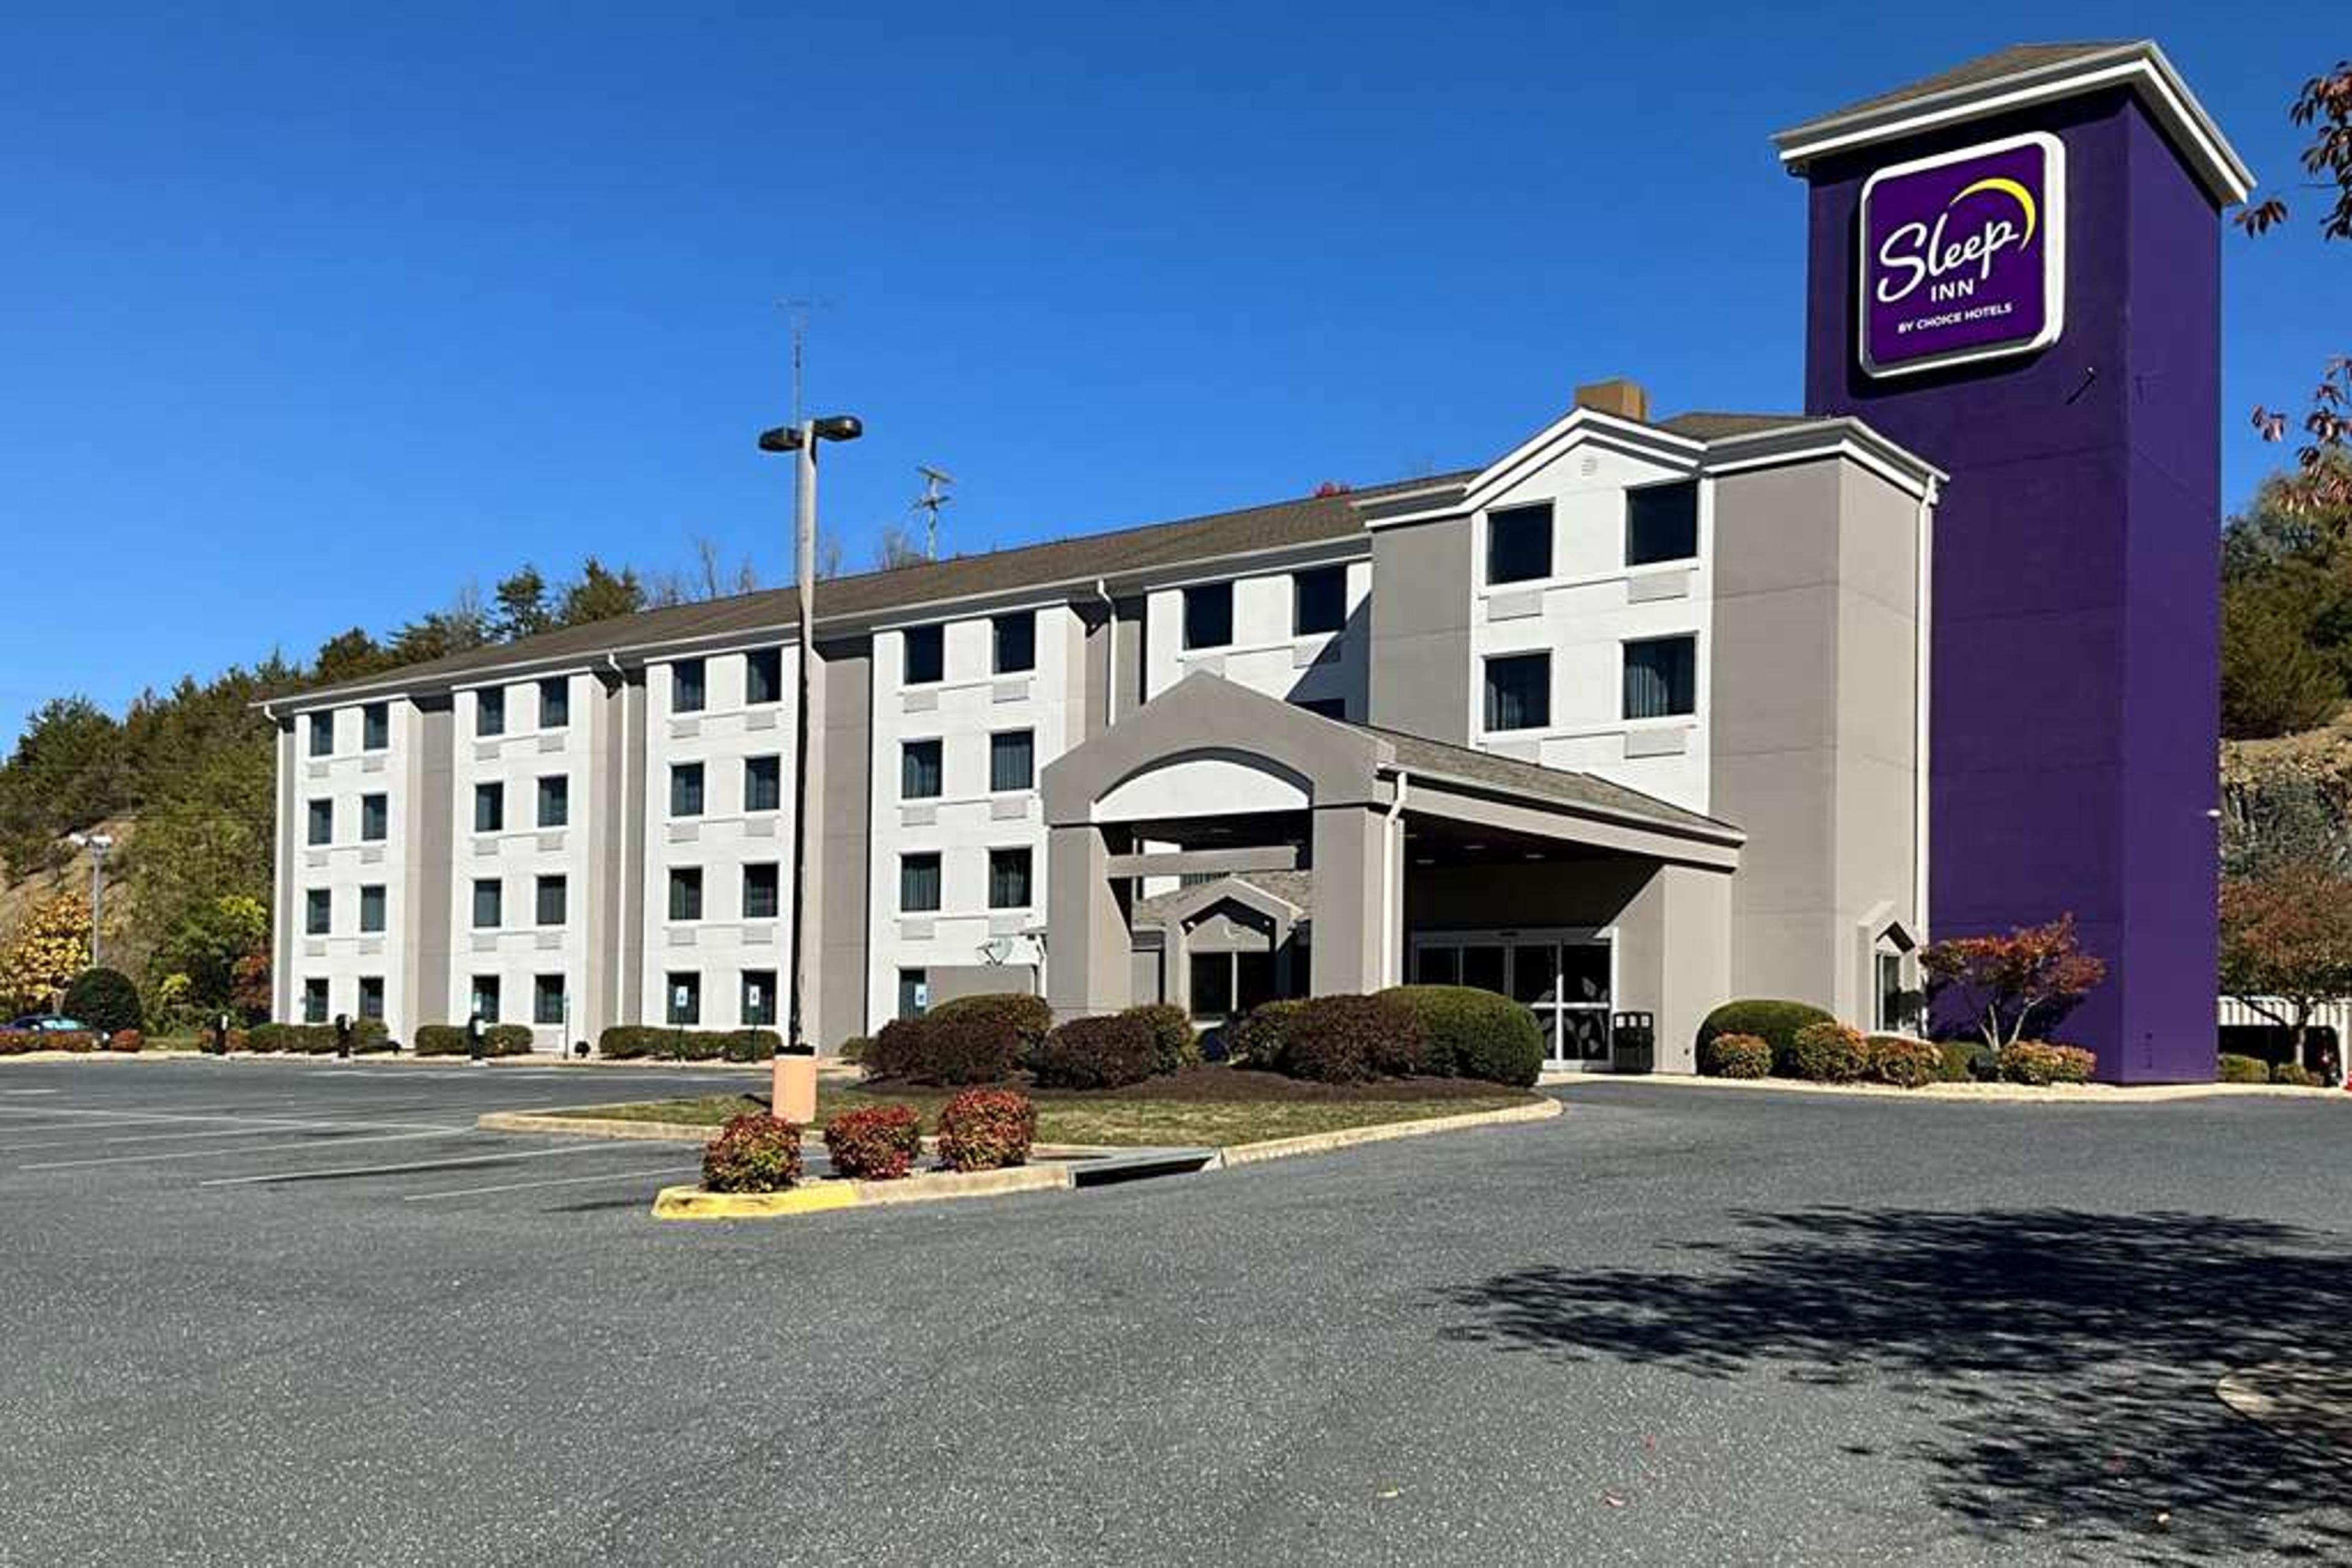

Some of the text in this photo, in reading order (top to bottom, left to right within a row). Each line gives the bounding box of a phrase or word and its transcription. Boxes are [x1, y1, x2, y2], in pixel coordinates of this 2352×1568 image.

[1877, 213, 2019, 303] Sleep
[1931, 278, 1974, 302] INN
[1898, 303, 2012, 333] BY CHOICE HOTELS
